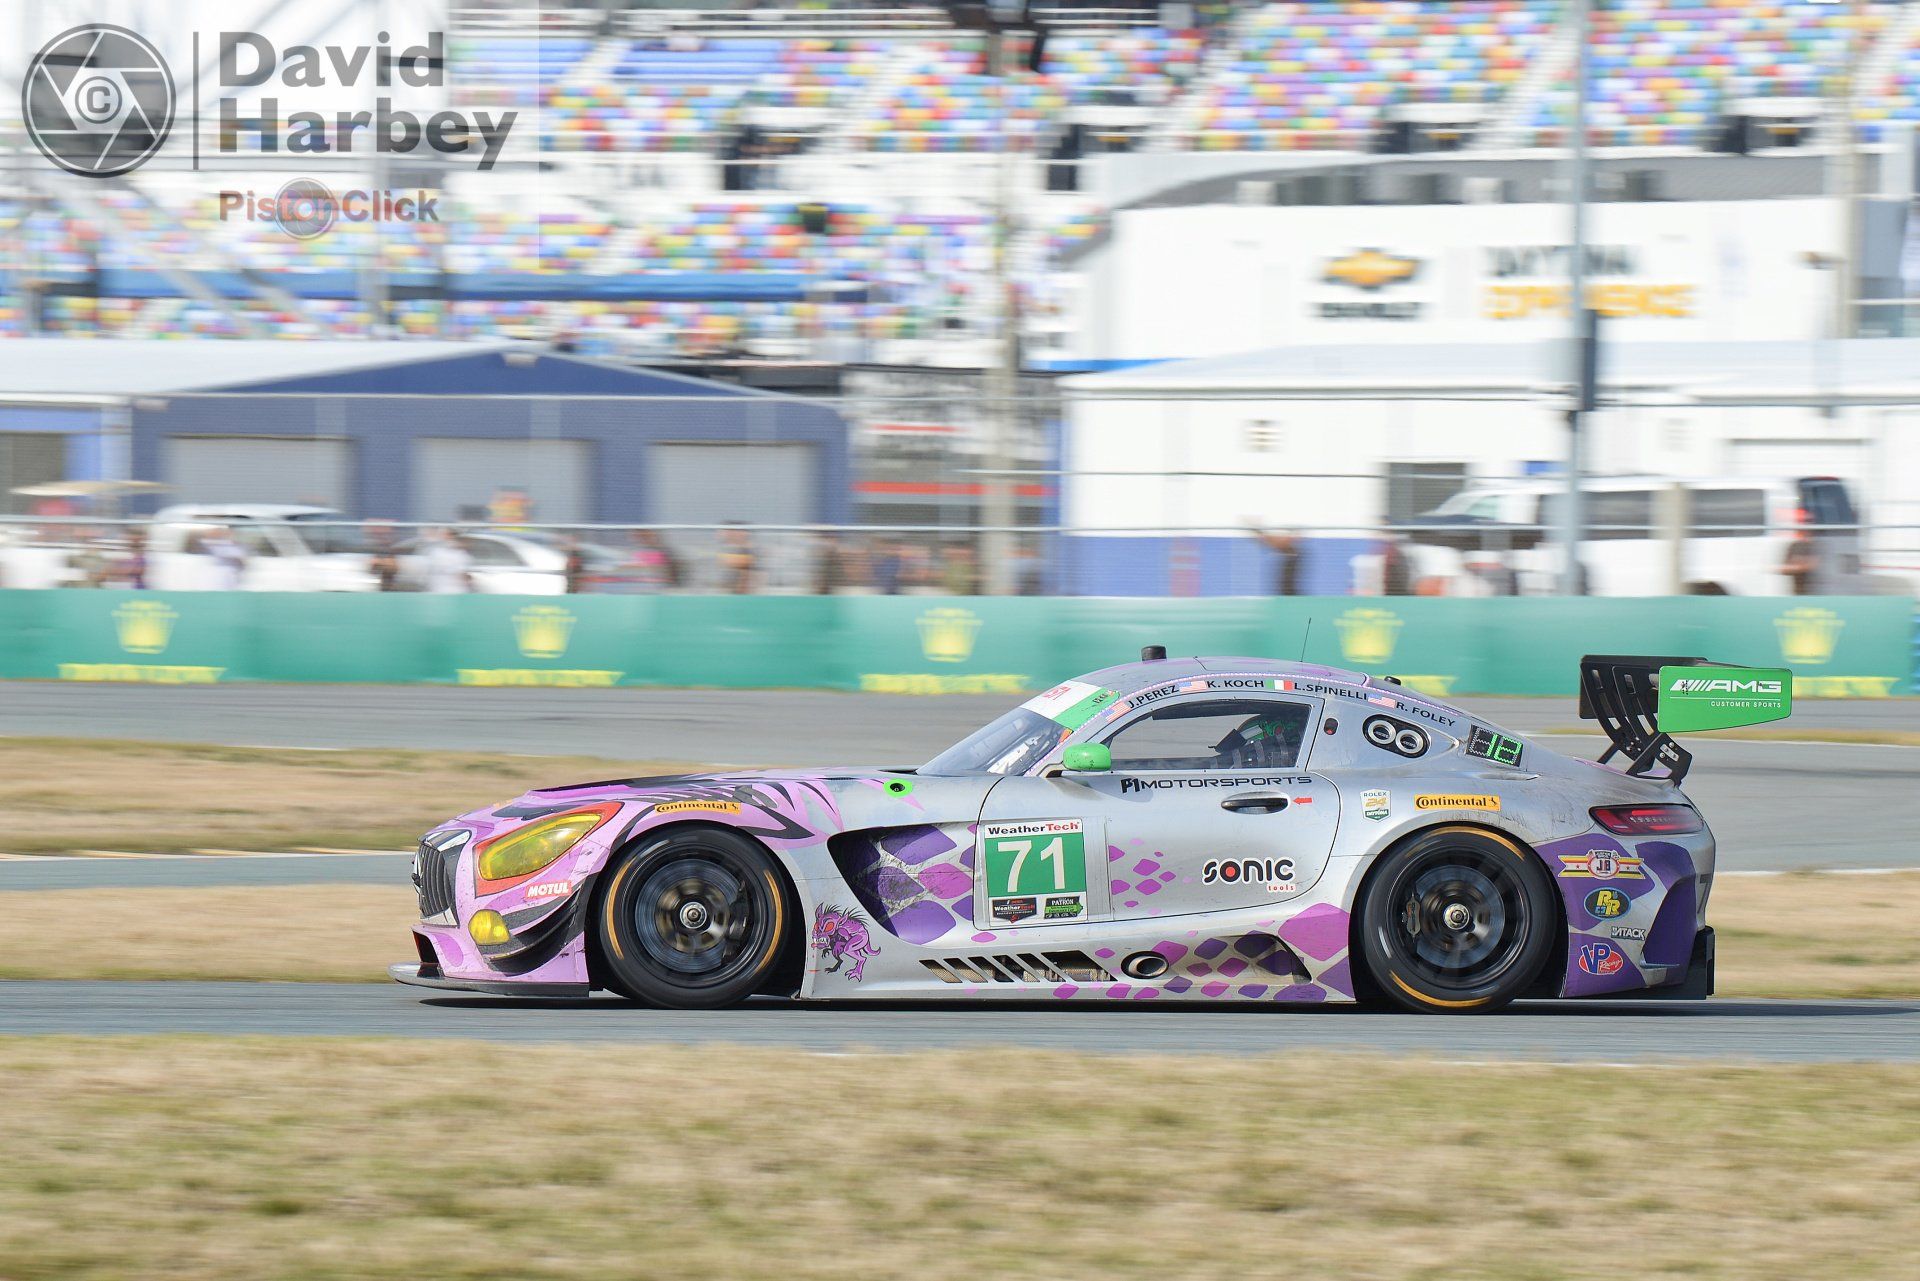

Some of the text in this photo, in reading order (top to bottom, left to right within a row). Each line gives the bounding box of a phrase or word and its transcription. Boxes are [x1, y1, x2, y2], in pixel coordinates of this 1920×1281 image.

[1224, 680, 1265, 688] KOCH
[1294, 682, 1367, 701] L.SPINELLI
[1127, 684, 1180, 709] J.PEREZ
[1412, 706, 1456, 727] FOLEY
[656, 802, 727, 812] Continental
[1415, 796, 1487, 809] Continental
[988, 822, 1079, 835] WeatherTech
[997, 837, 1066, 892] 71
[527, 882, 569, 897] MOTUL
[1580, 944, 1612, 975] VP
